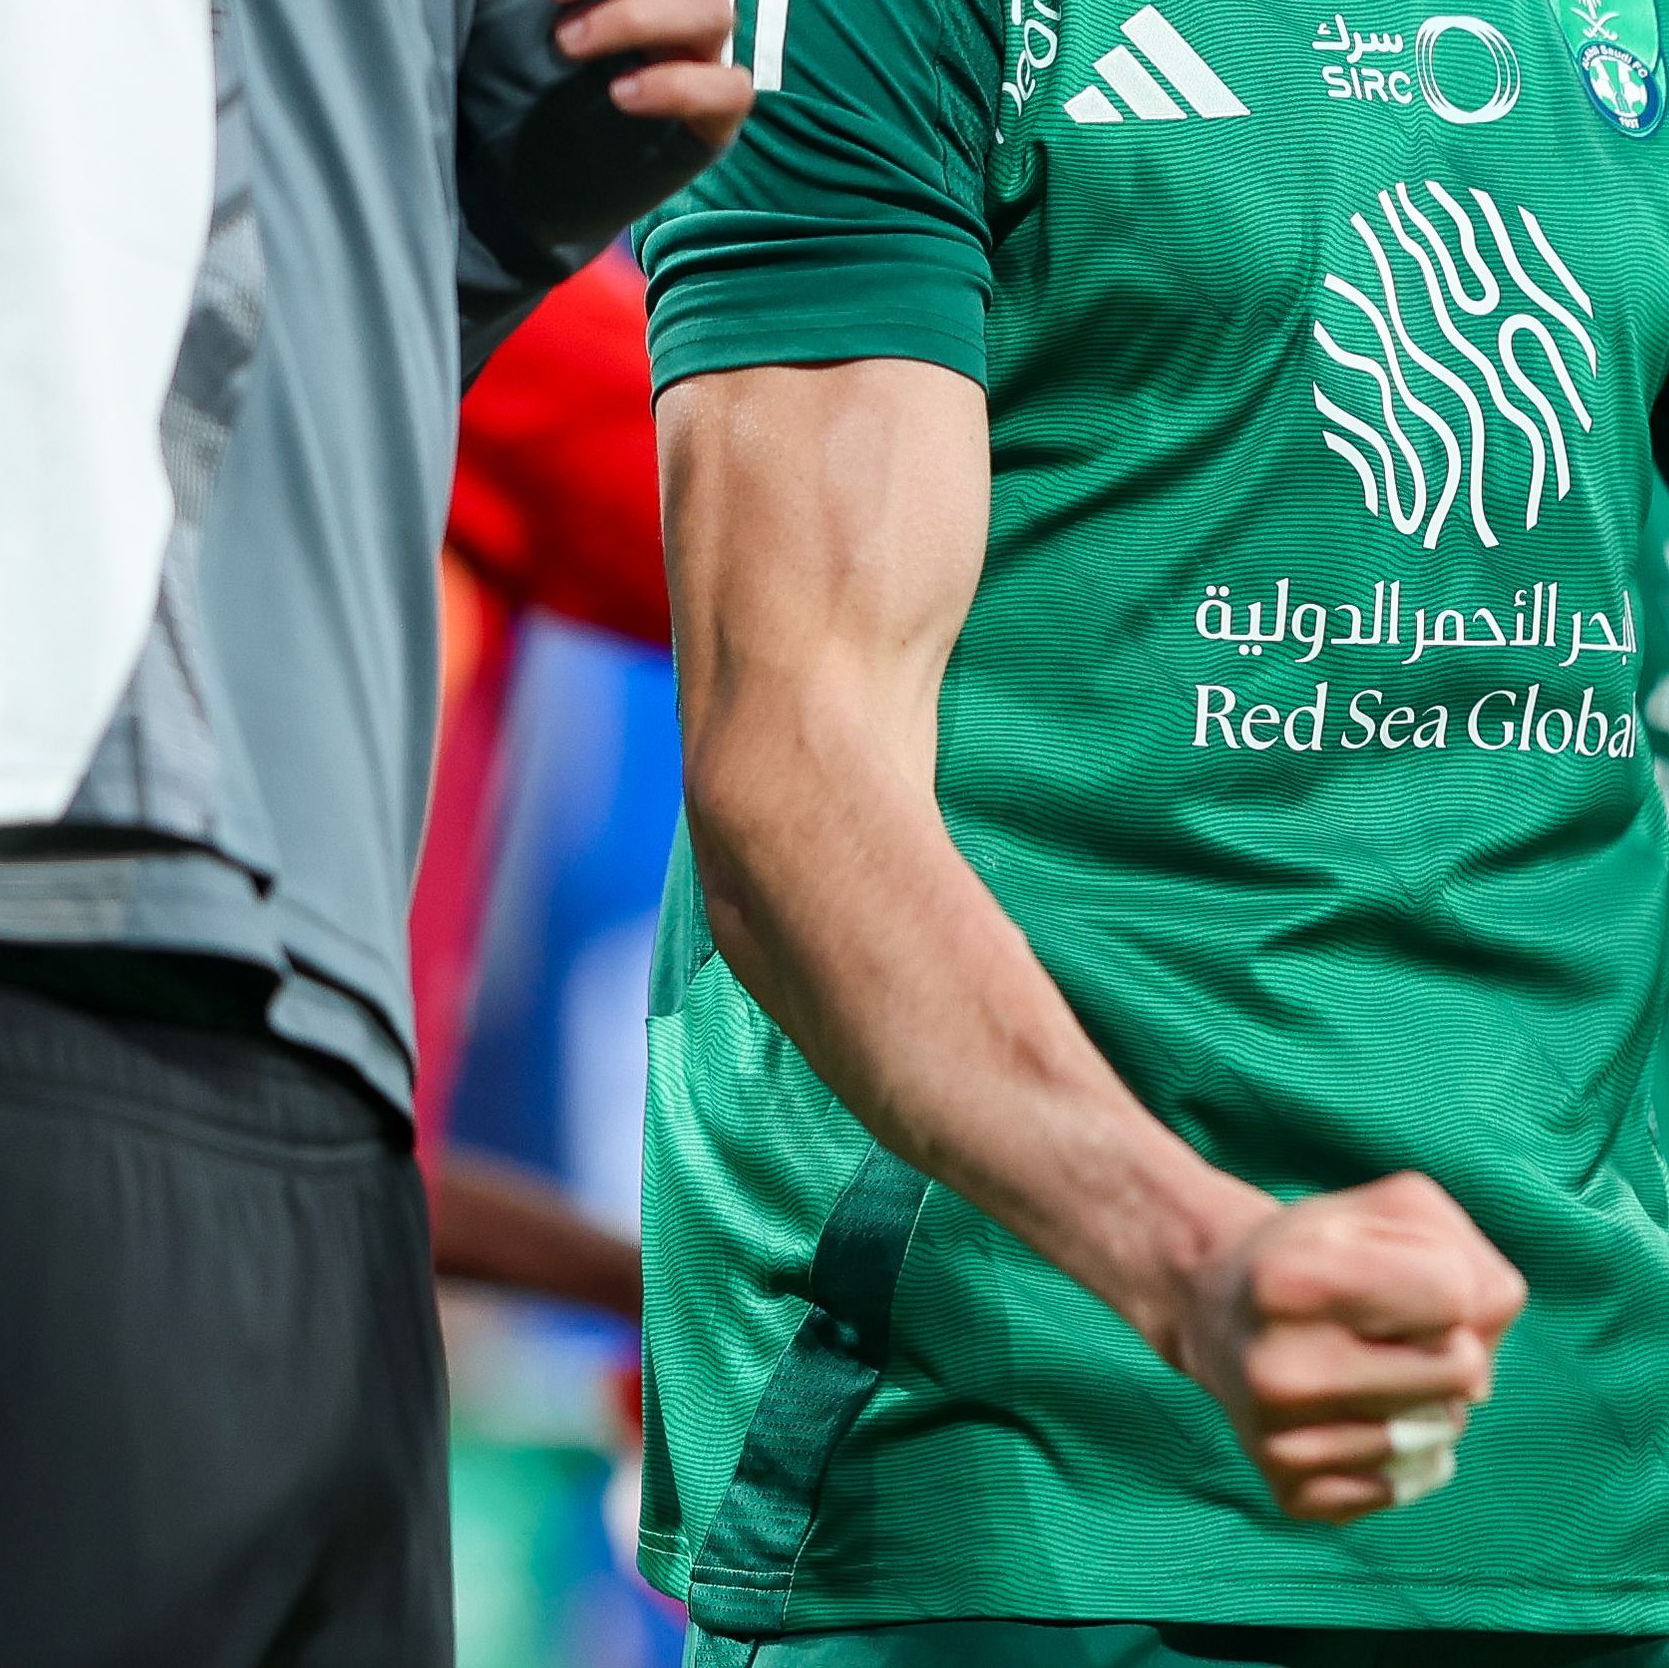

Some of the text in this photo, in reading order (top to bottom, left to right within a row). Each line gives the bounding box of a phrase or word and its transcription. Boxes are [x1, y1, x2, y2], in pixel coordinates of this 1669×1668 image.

[1311, 13, 1404, 64] سرك
[1321, 65, 1413, 105] SIRC
[1195, 577, 1400, 663] الدولية
[1401, 581, 1559, 665] الأحمر
[1191, 680, 1637, 759] Red Sea Global
